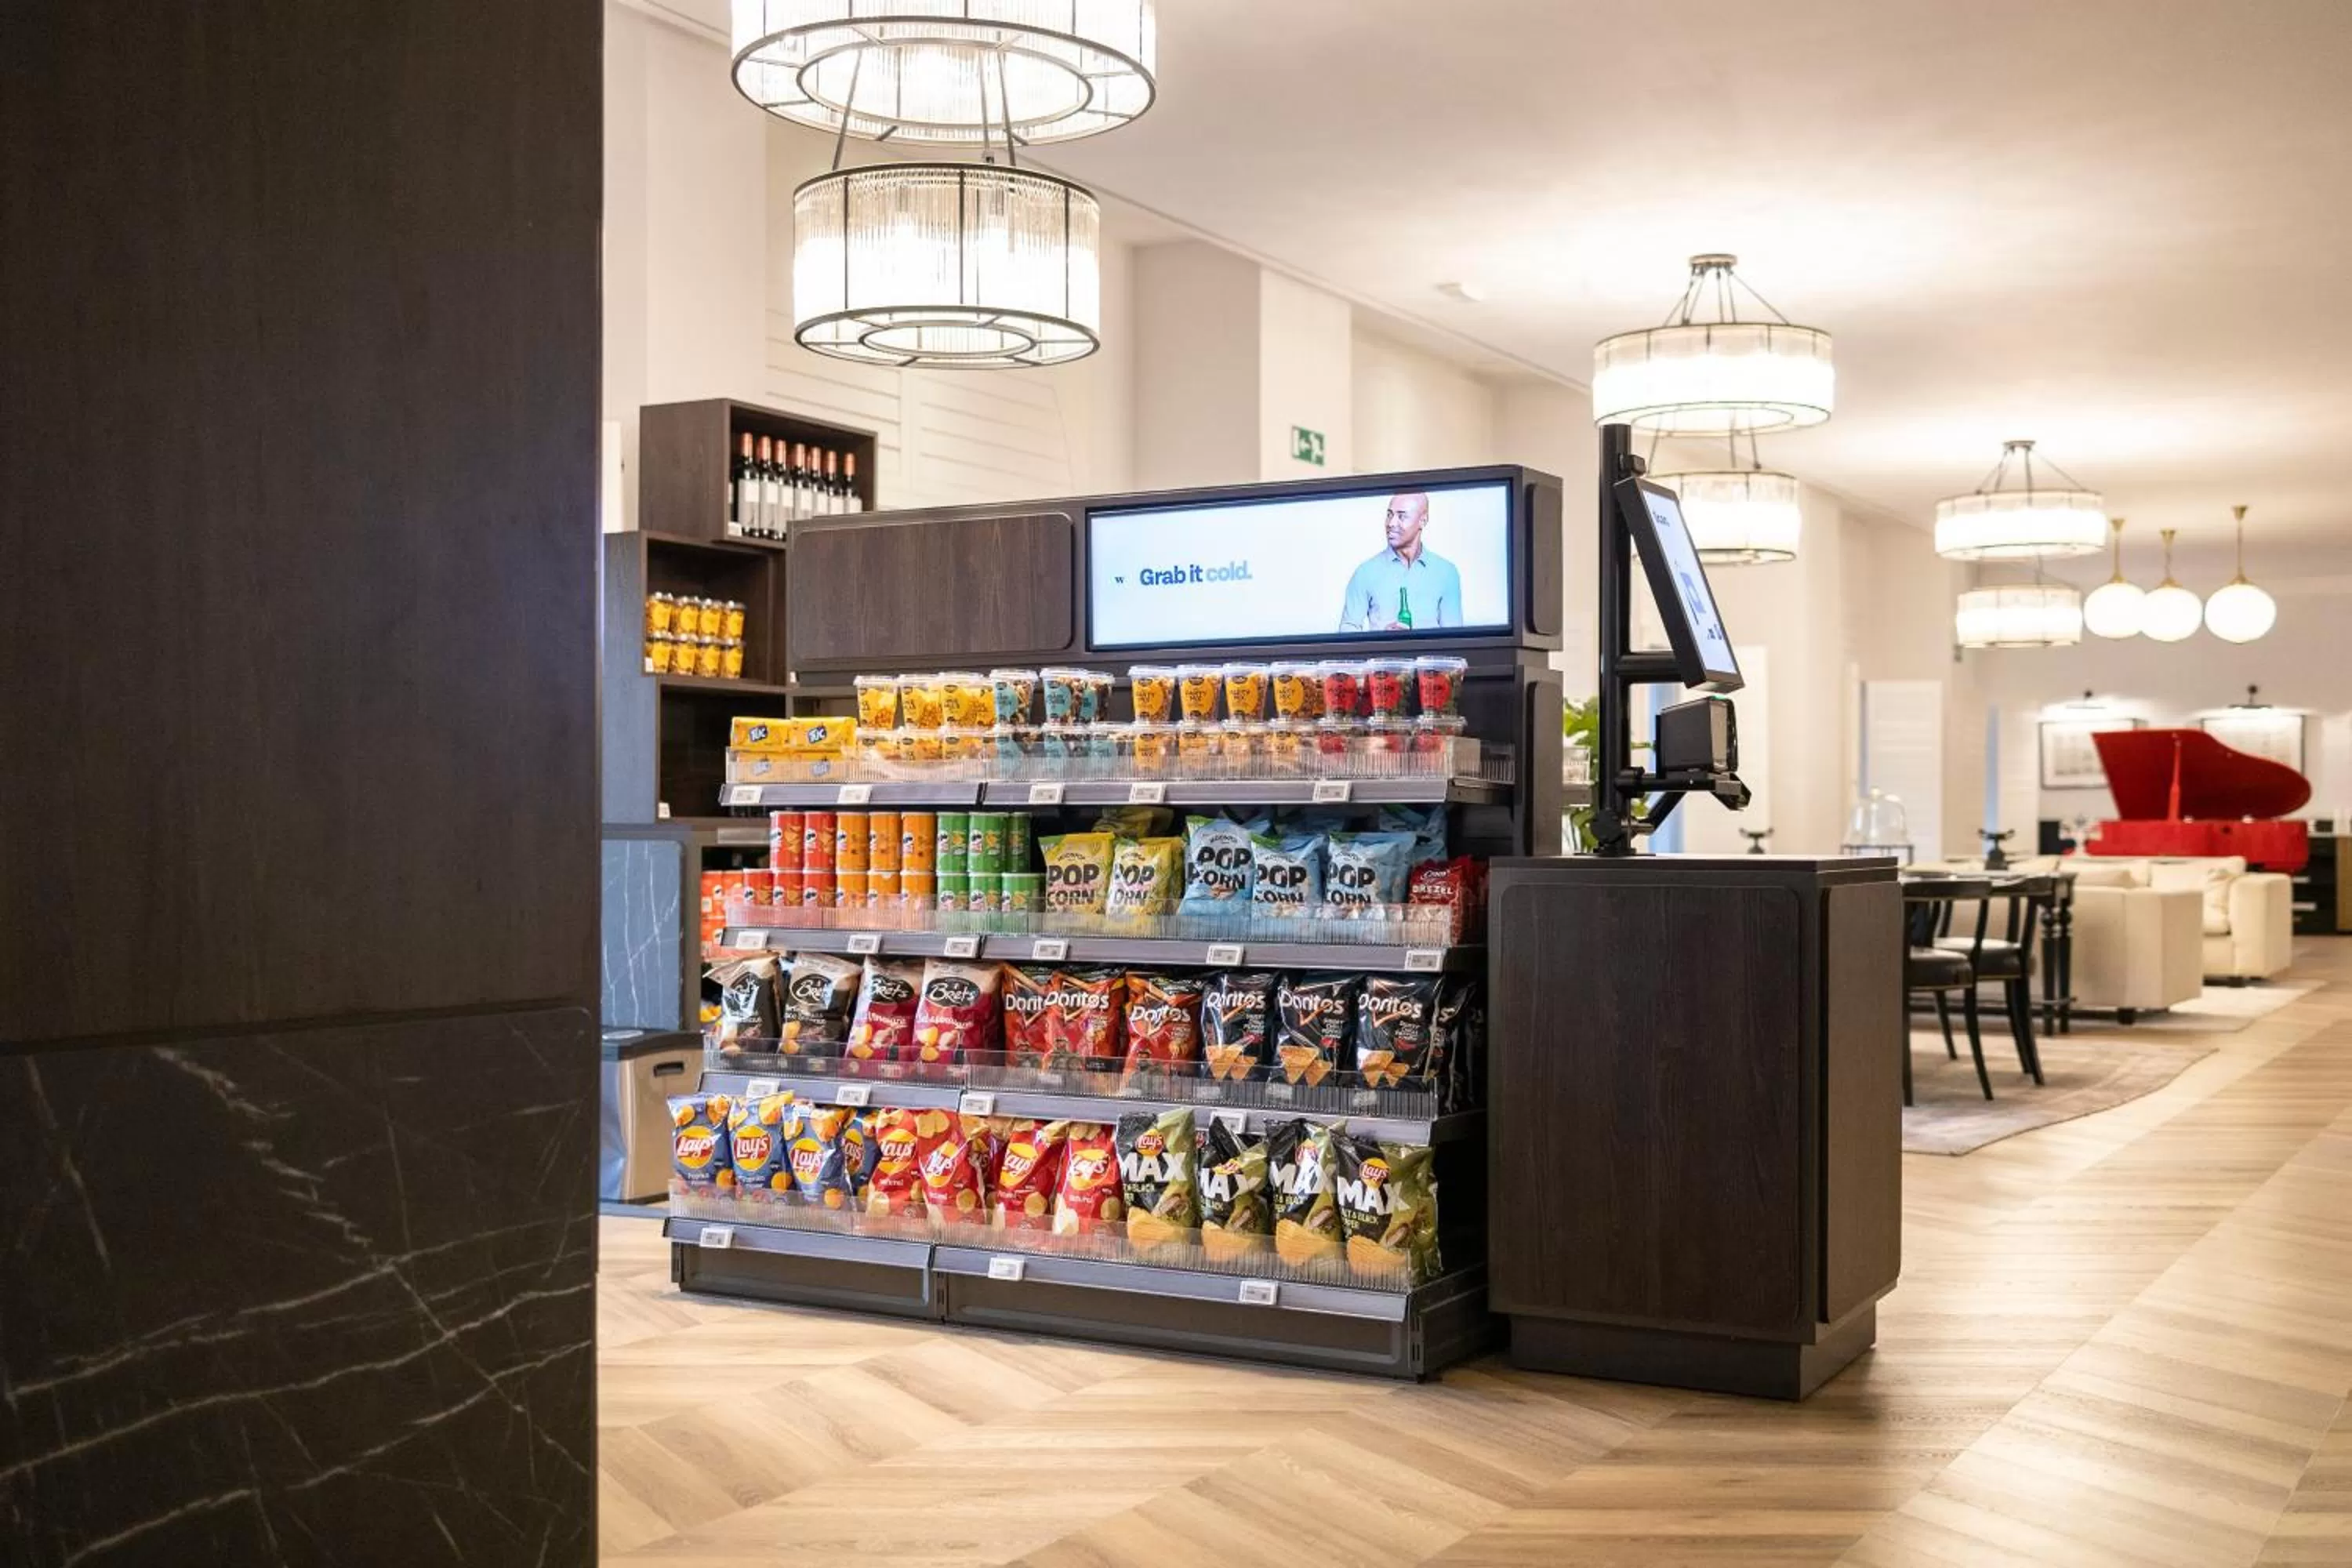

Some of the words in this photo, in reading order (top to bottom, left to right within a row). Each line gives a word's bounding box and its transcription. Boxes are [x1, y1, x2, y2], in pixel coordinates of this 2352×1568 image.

[1140, 565, 1186, 586] Grab
[1189, 564, 1203, 583] it
[1207, 561, 1253, 582] cold.
[809, 727, 827, 742] TUC
[1197, 846, 1252, 869] POP
[1047, 863, 1100, 887] POP
[1256, 863, 1307, 887] POP
[1328, 862, 1376, 887] POP
[1047, 889, 1095, 907] CORN
[1005, 993, 1046, 1011] Dorit
[1045, 990, 1109, 1009] Doritos
[1207, 990, 1266, 1009] Doritos
[1280, 989, 1345, 1015] Doritos
[1358, 993, 1423, 1019] Doritos
[1130, 1005, 1191, 1022] Doritos
[1117, 1152, 1188, 1181] MAX
[1270, 1161, 1338, 1194] MAX
[1338, 1176, 1410, 1216] MAX
